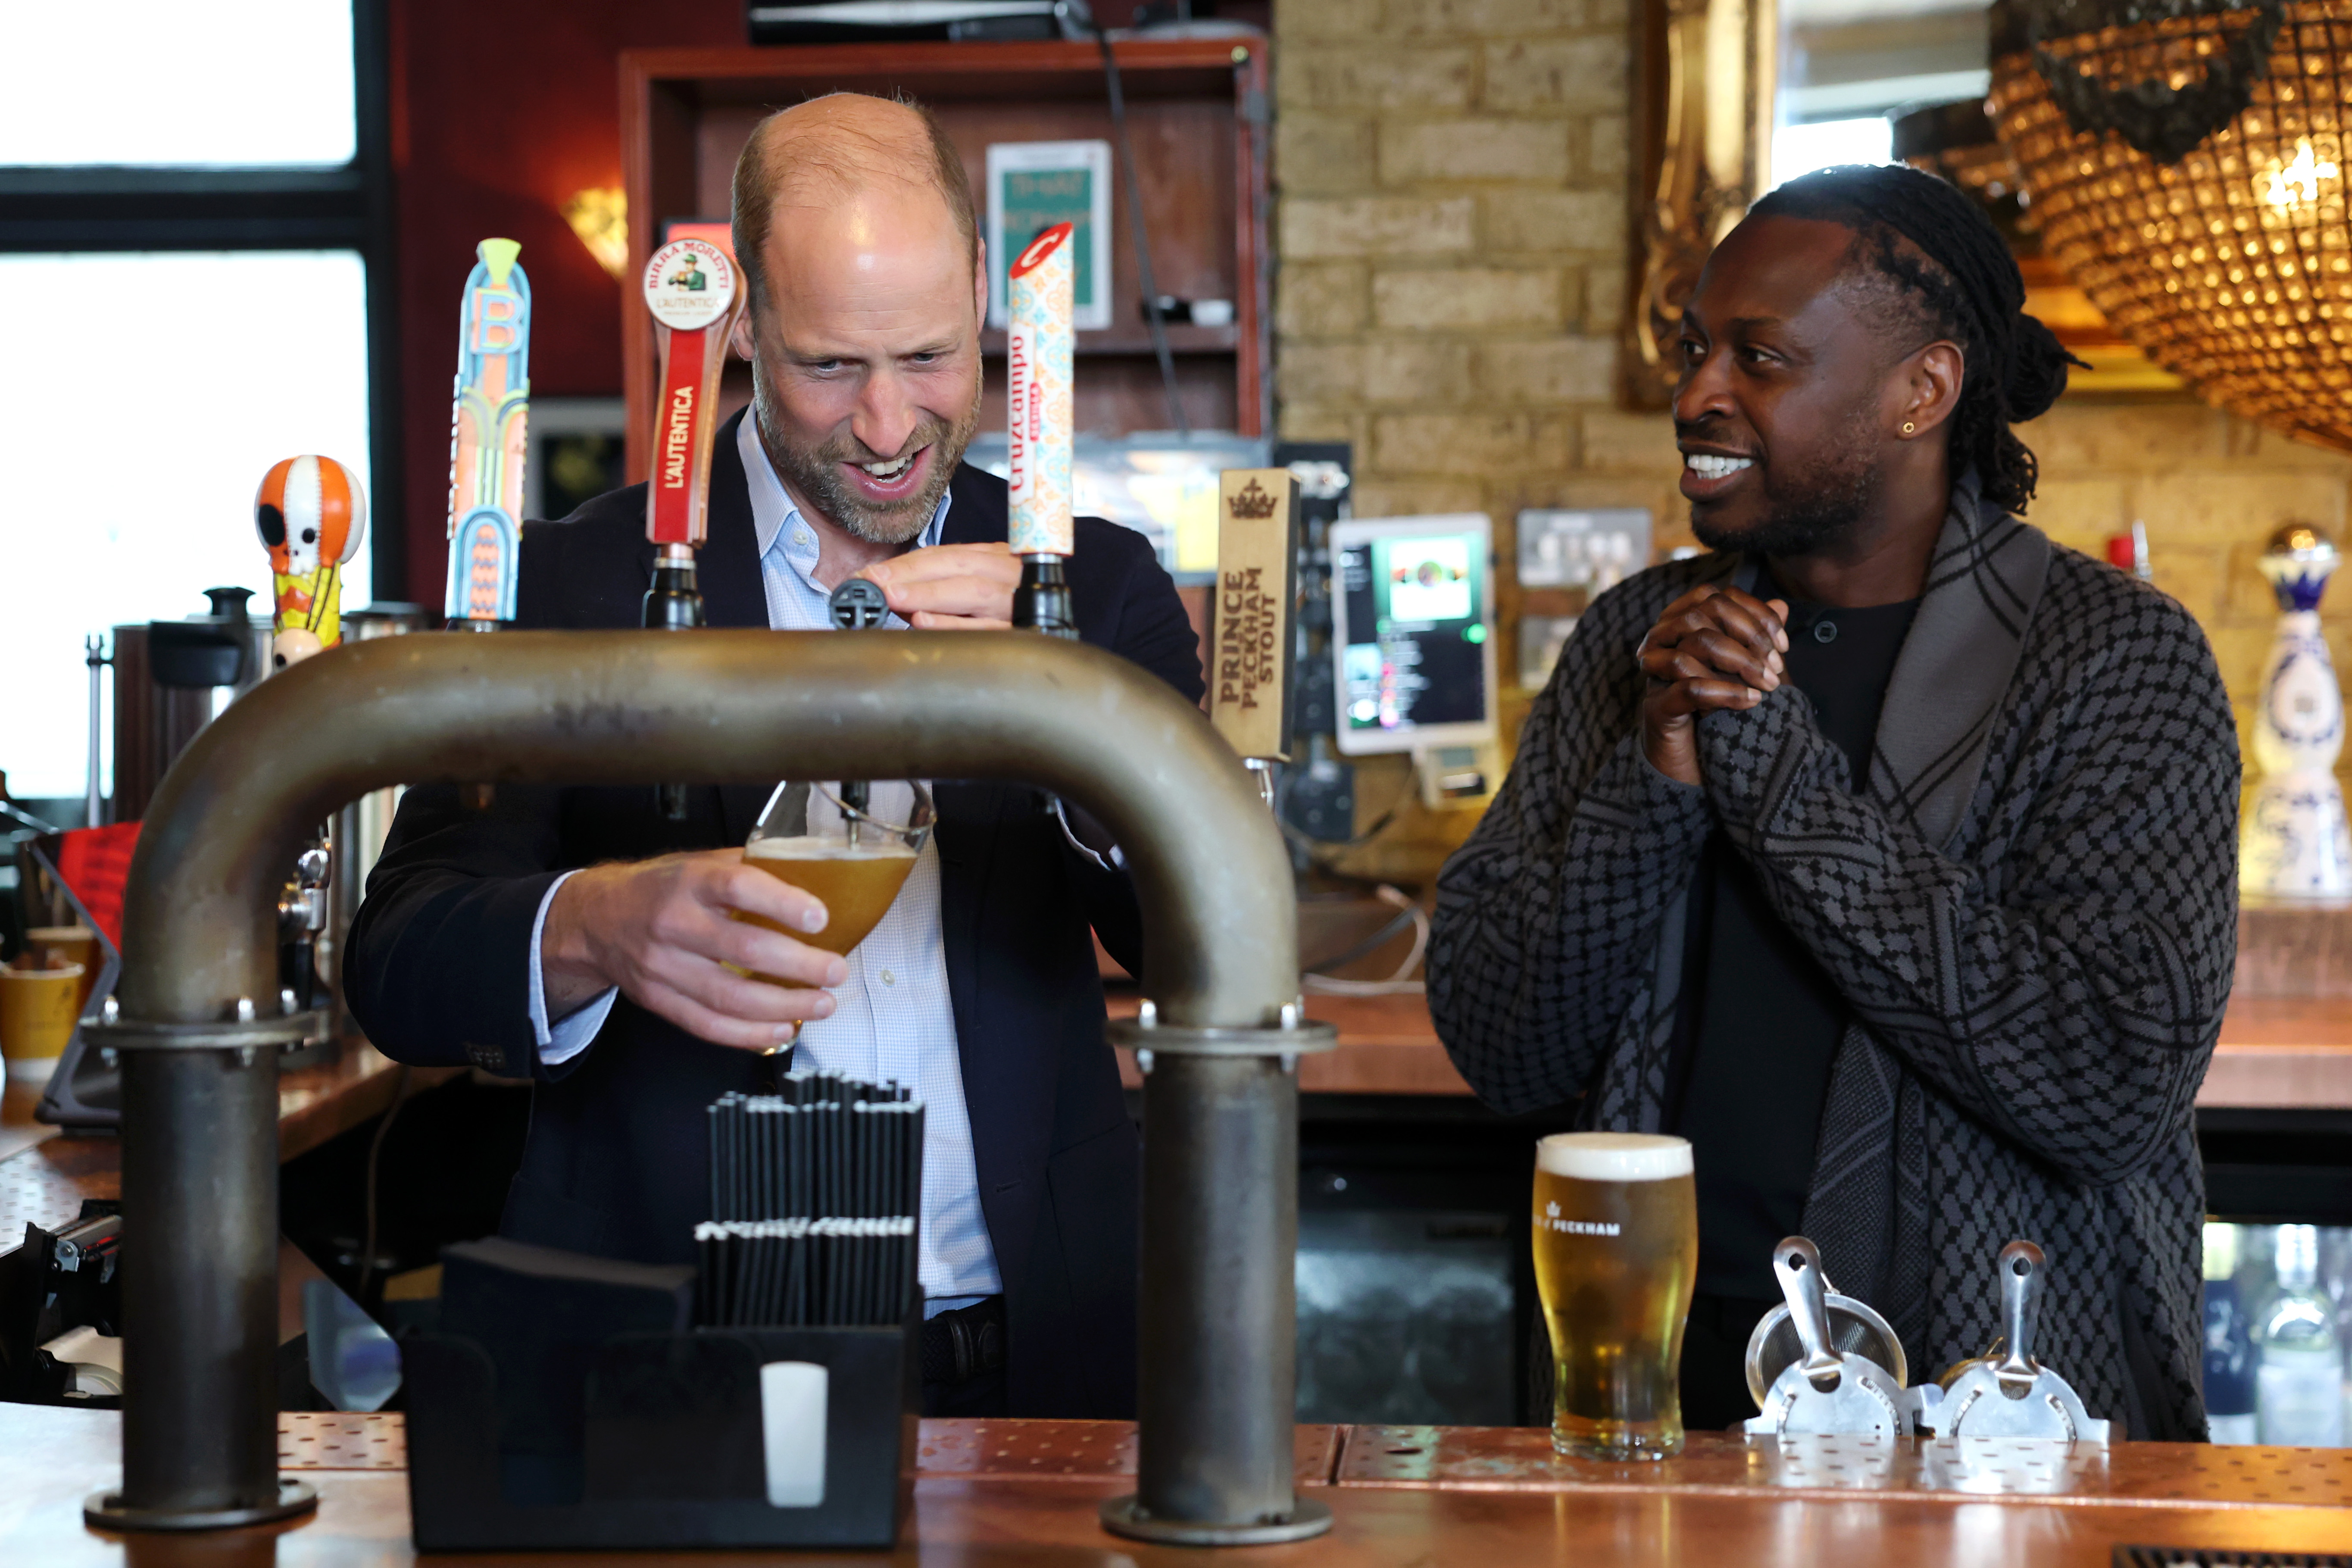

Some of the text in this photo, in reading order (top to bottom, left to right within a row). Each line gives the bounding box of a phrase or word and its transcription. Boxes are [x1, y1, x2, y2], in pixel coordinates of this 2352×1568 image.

[649, 242, 729, 289] BIRRA MORETTI
[470, 286, 525, 355] B
[664, 385, 694, 489] L'AUTENTICA
[1220, 571, 1244, 703] PRINCE
[1241, 567, 1262, 709] PECKHAM
[1259, 593, 1276, 683] STOUT
[1552, 1219, 1621, 1236] PECKHAM
